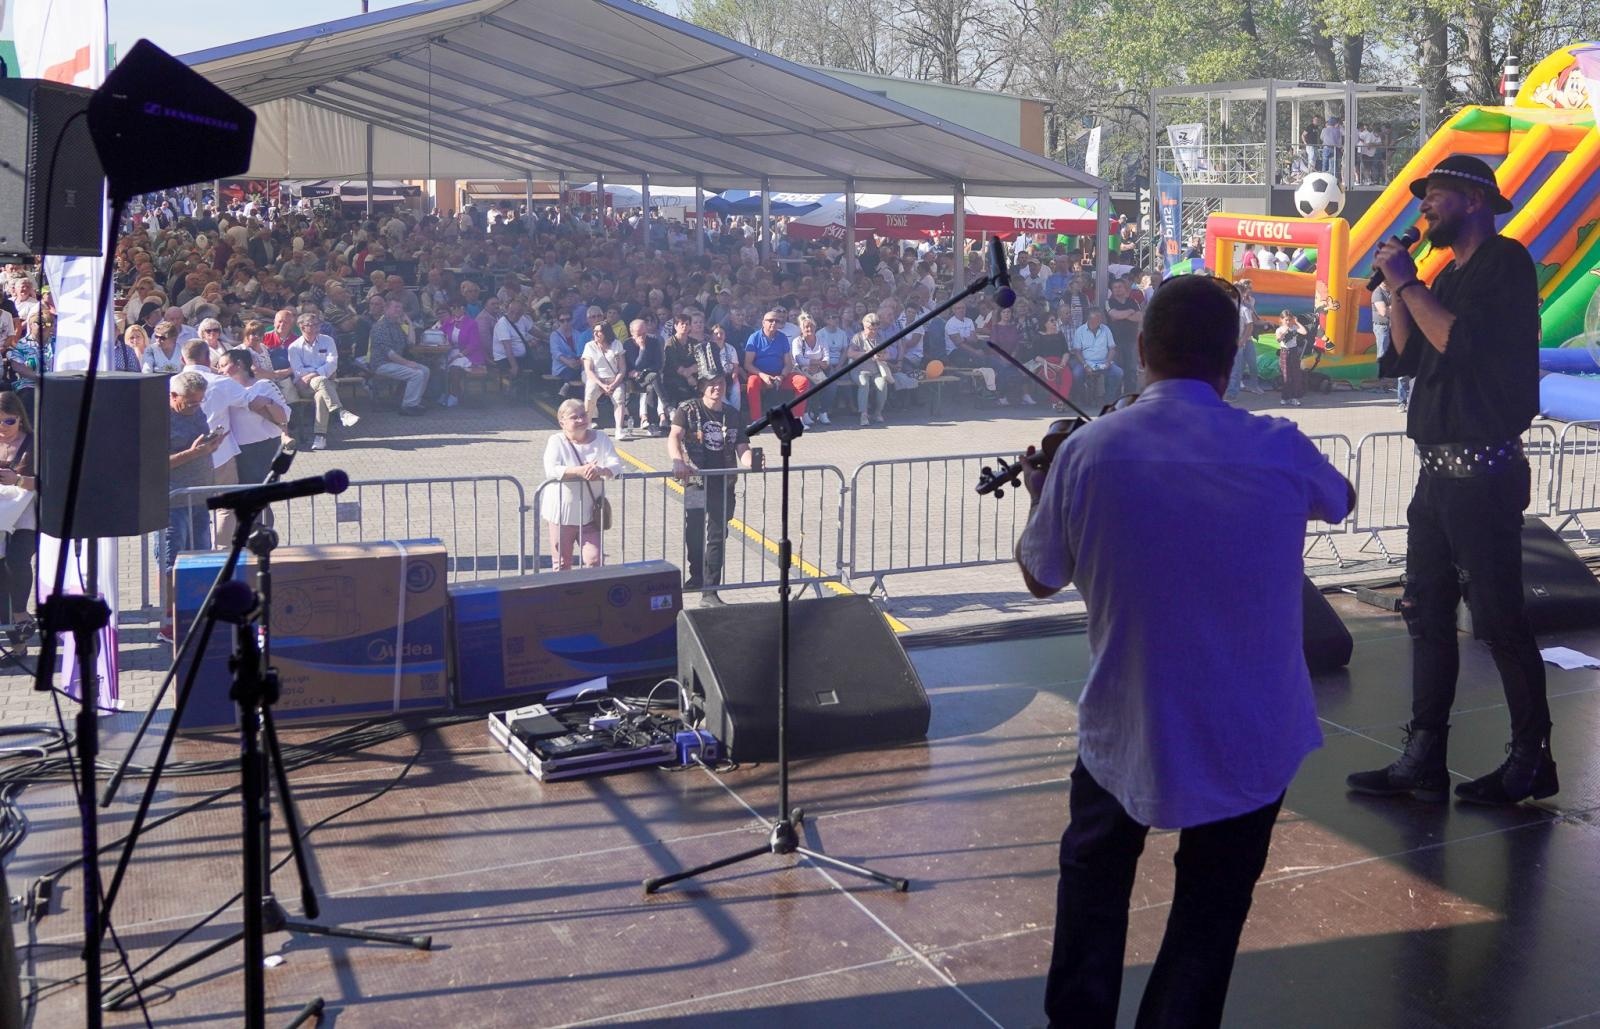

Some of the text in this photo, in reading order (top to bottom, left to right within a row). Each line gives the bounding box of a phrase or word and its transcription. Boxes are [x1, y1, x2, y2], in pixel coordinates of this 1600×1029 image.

[884, 214, 910, 227] TYSKIE
[1013, 217, 1056, 230] TYSKIE
[1237, 219, 1293, 240] FUTBOL
[369, 640, 433, 659] Mdea
